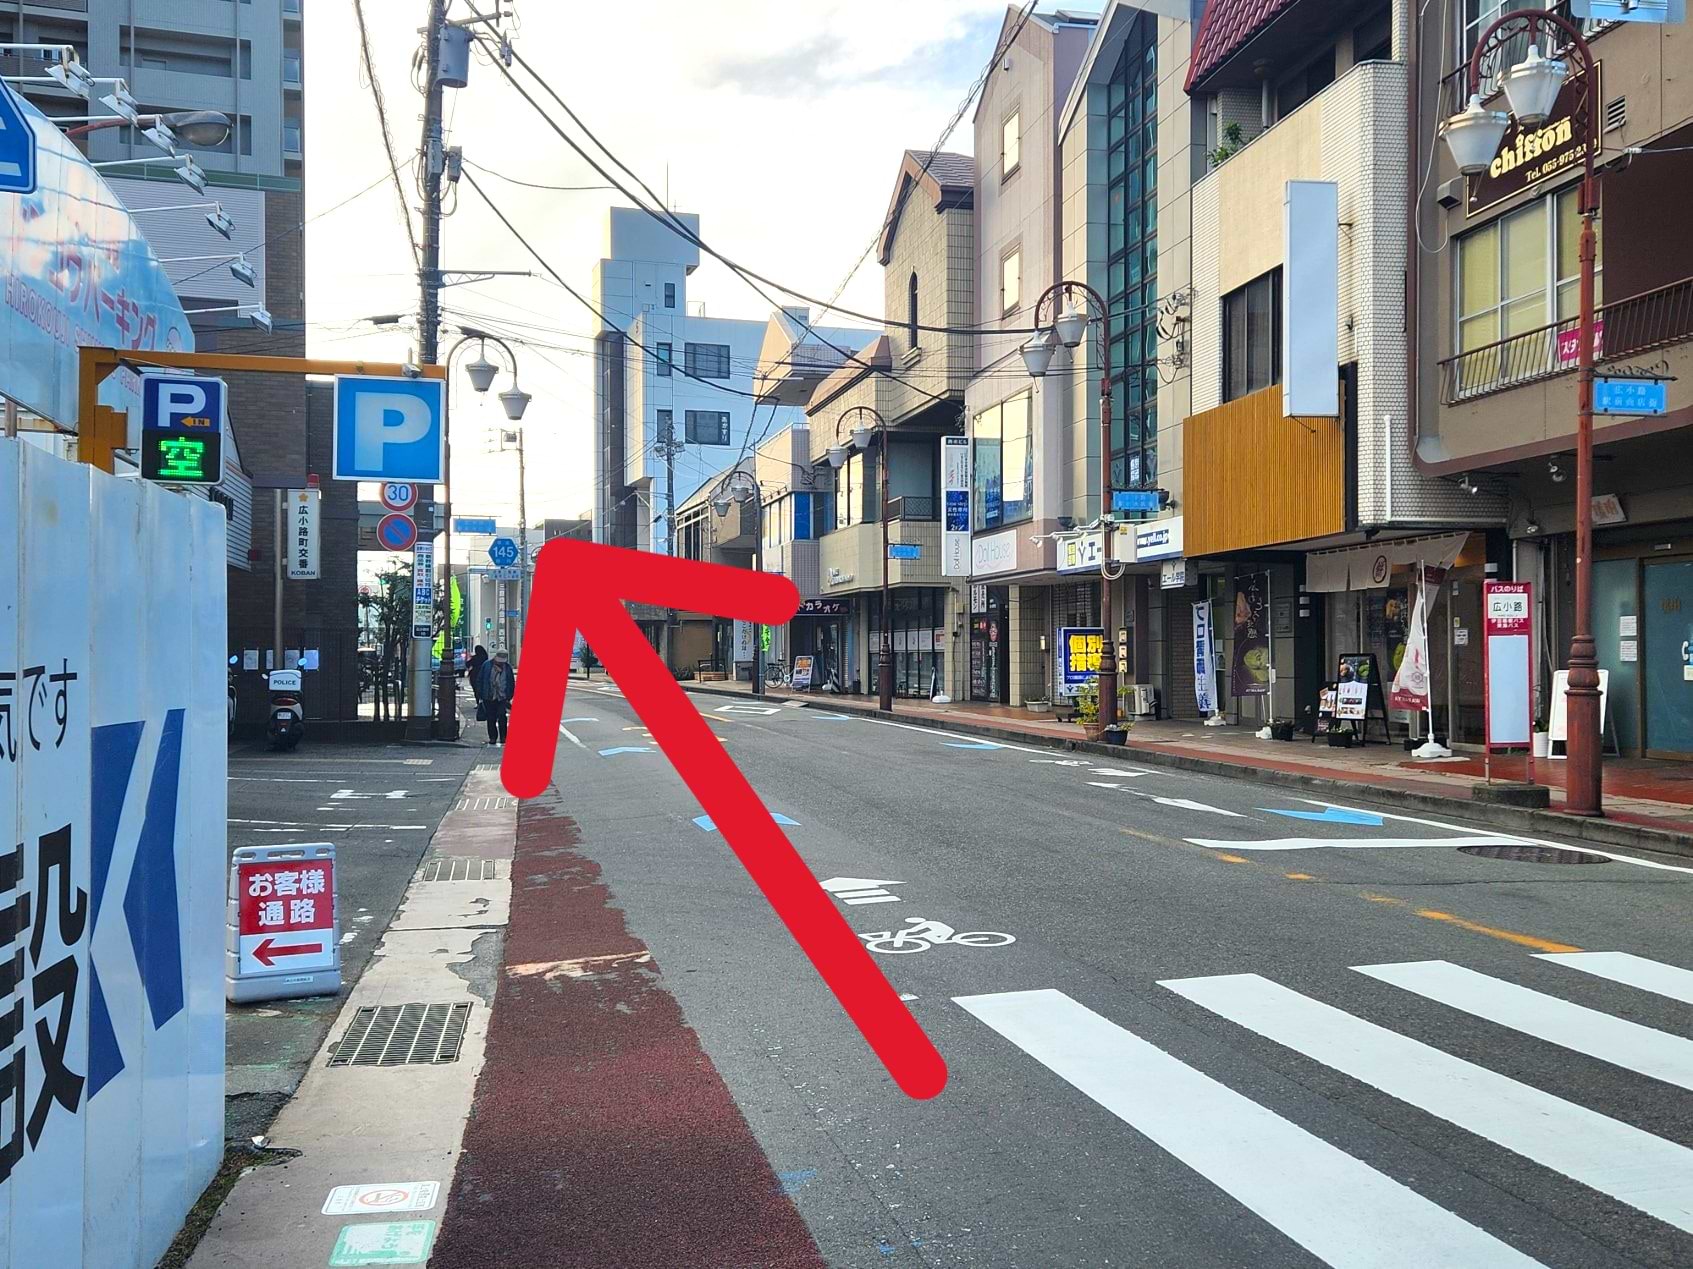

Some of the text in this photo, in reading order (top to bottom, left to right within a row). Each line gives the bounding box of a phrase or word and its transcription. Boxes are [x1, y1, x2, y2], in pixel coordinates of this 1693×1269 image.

[1489, 120, 1572, 178] chiffon
[157, 383, 207, 427] P
[192, 417, 205, 426] IN
[354, 392, 432, 472] P
[158, 435, 205, 477] 空
[387, 485, 409, 501] 30
[298, 505, 309, 569] 広小路町交番
[493, 546, 514, 558] 145
[1490, 585, 1524, 593] バスのりば
[1493, 601, 1523, 612] 広小路
[1069, 634, 1104, 653] 個別
[1069, 653, 1103, 672] 指導
[248, 869, 326, 897] お客様
[258, 899, 316, 927] 通路
